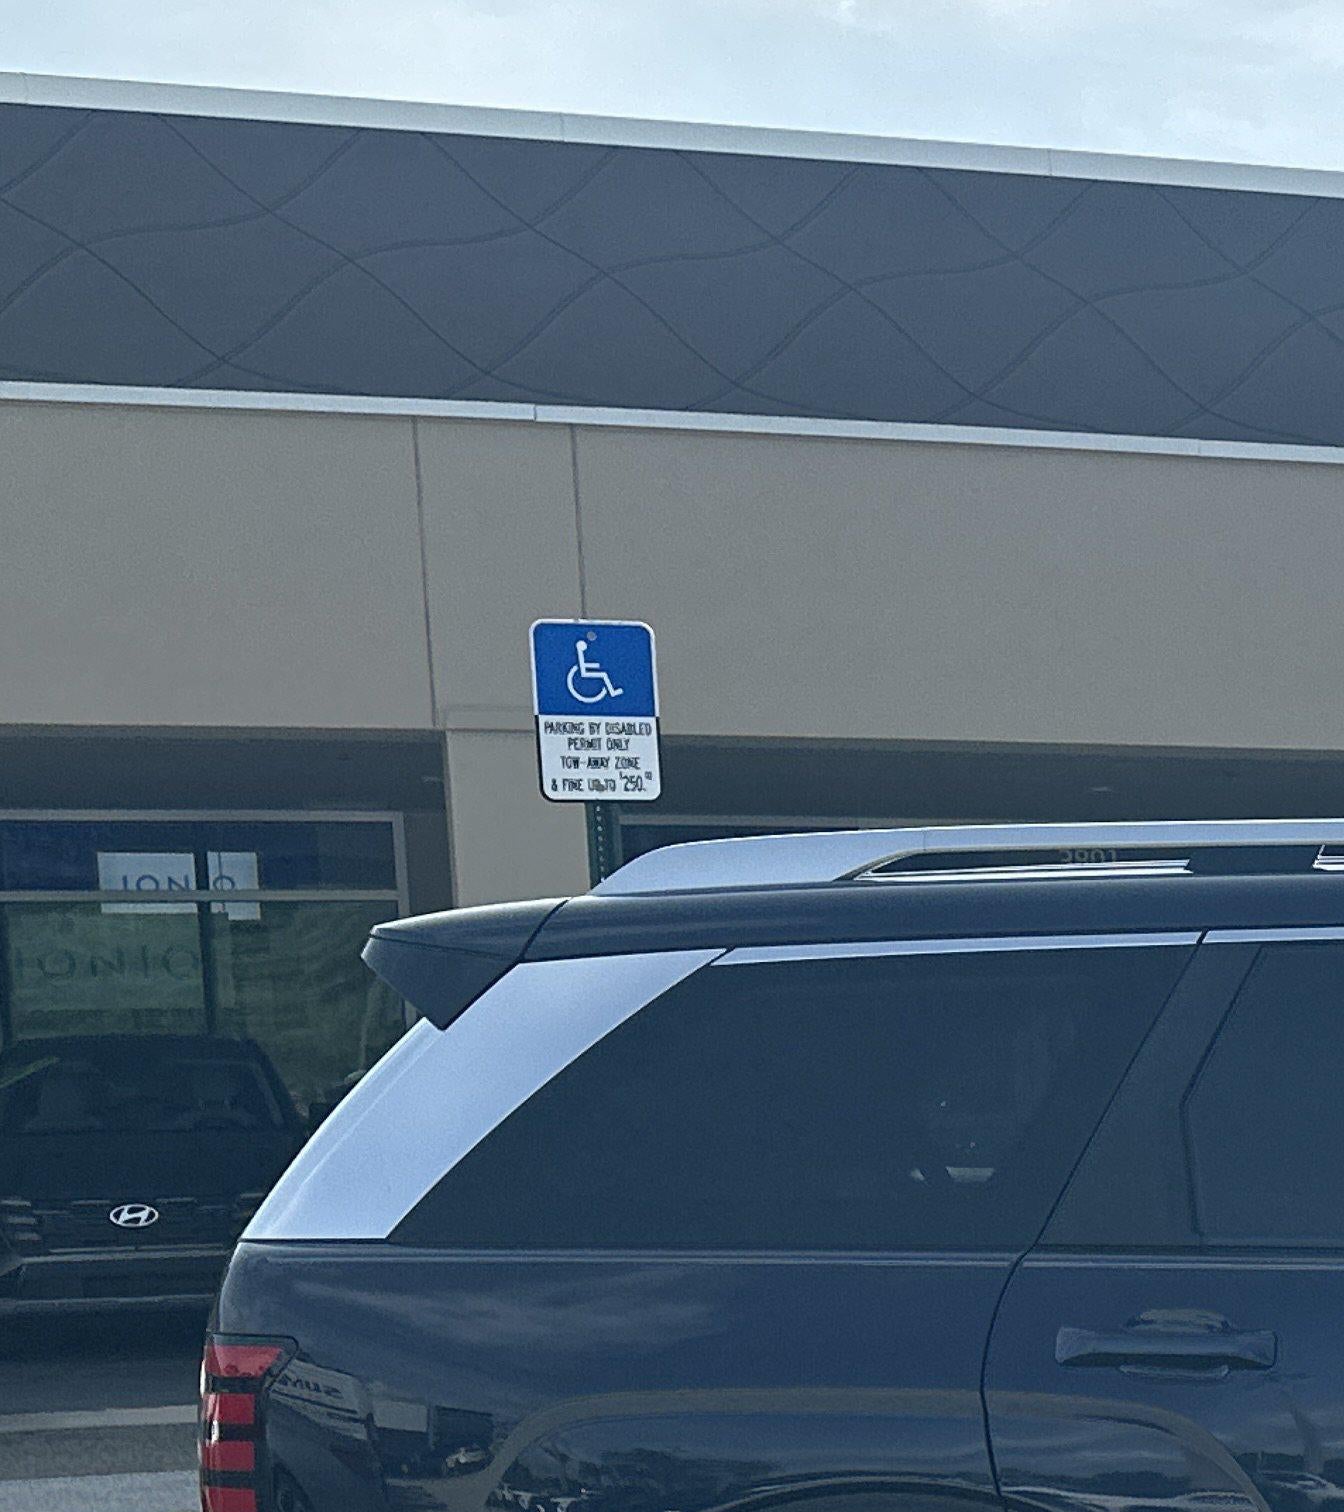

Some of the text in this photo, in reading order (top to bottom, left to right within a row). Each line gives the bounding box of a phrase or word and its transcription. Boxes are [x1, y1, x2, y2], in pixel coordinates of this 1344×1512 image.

[544, 721, 653, 737] PARKING BY DISABLED
[568, 738, 630, 751] PERMIT ONLY
[560, 756, 641, 770] TOW-AWAY ZONE
[551, 778, 558, 792] &
[562, 778, 584, 792] FINE
